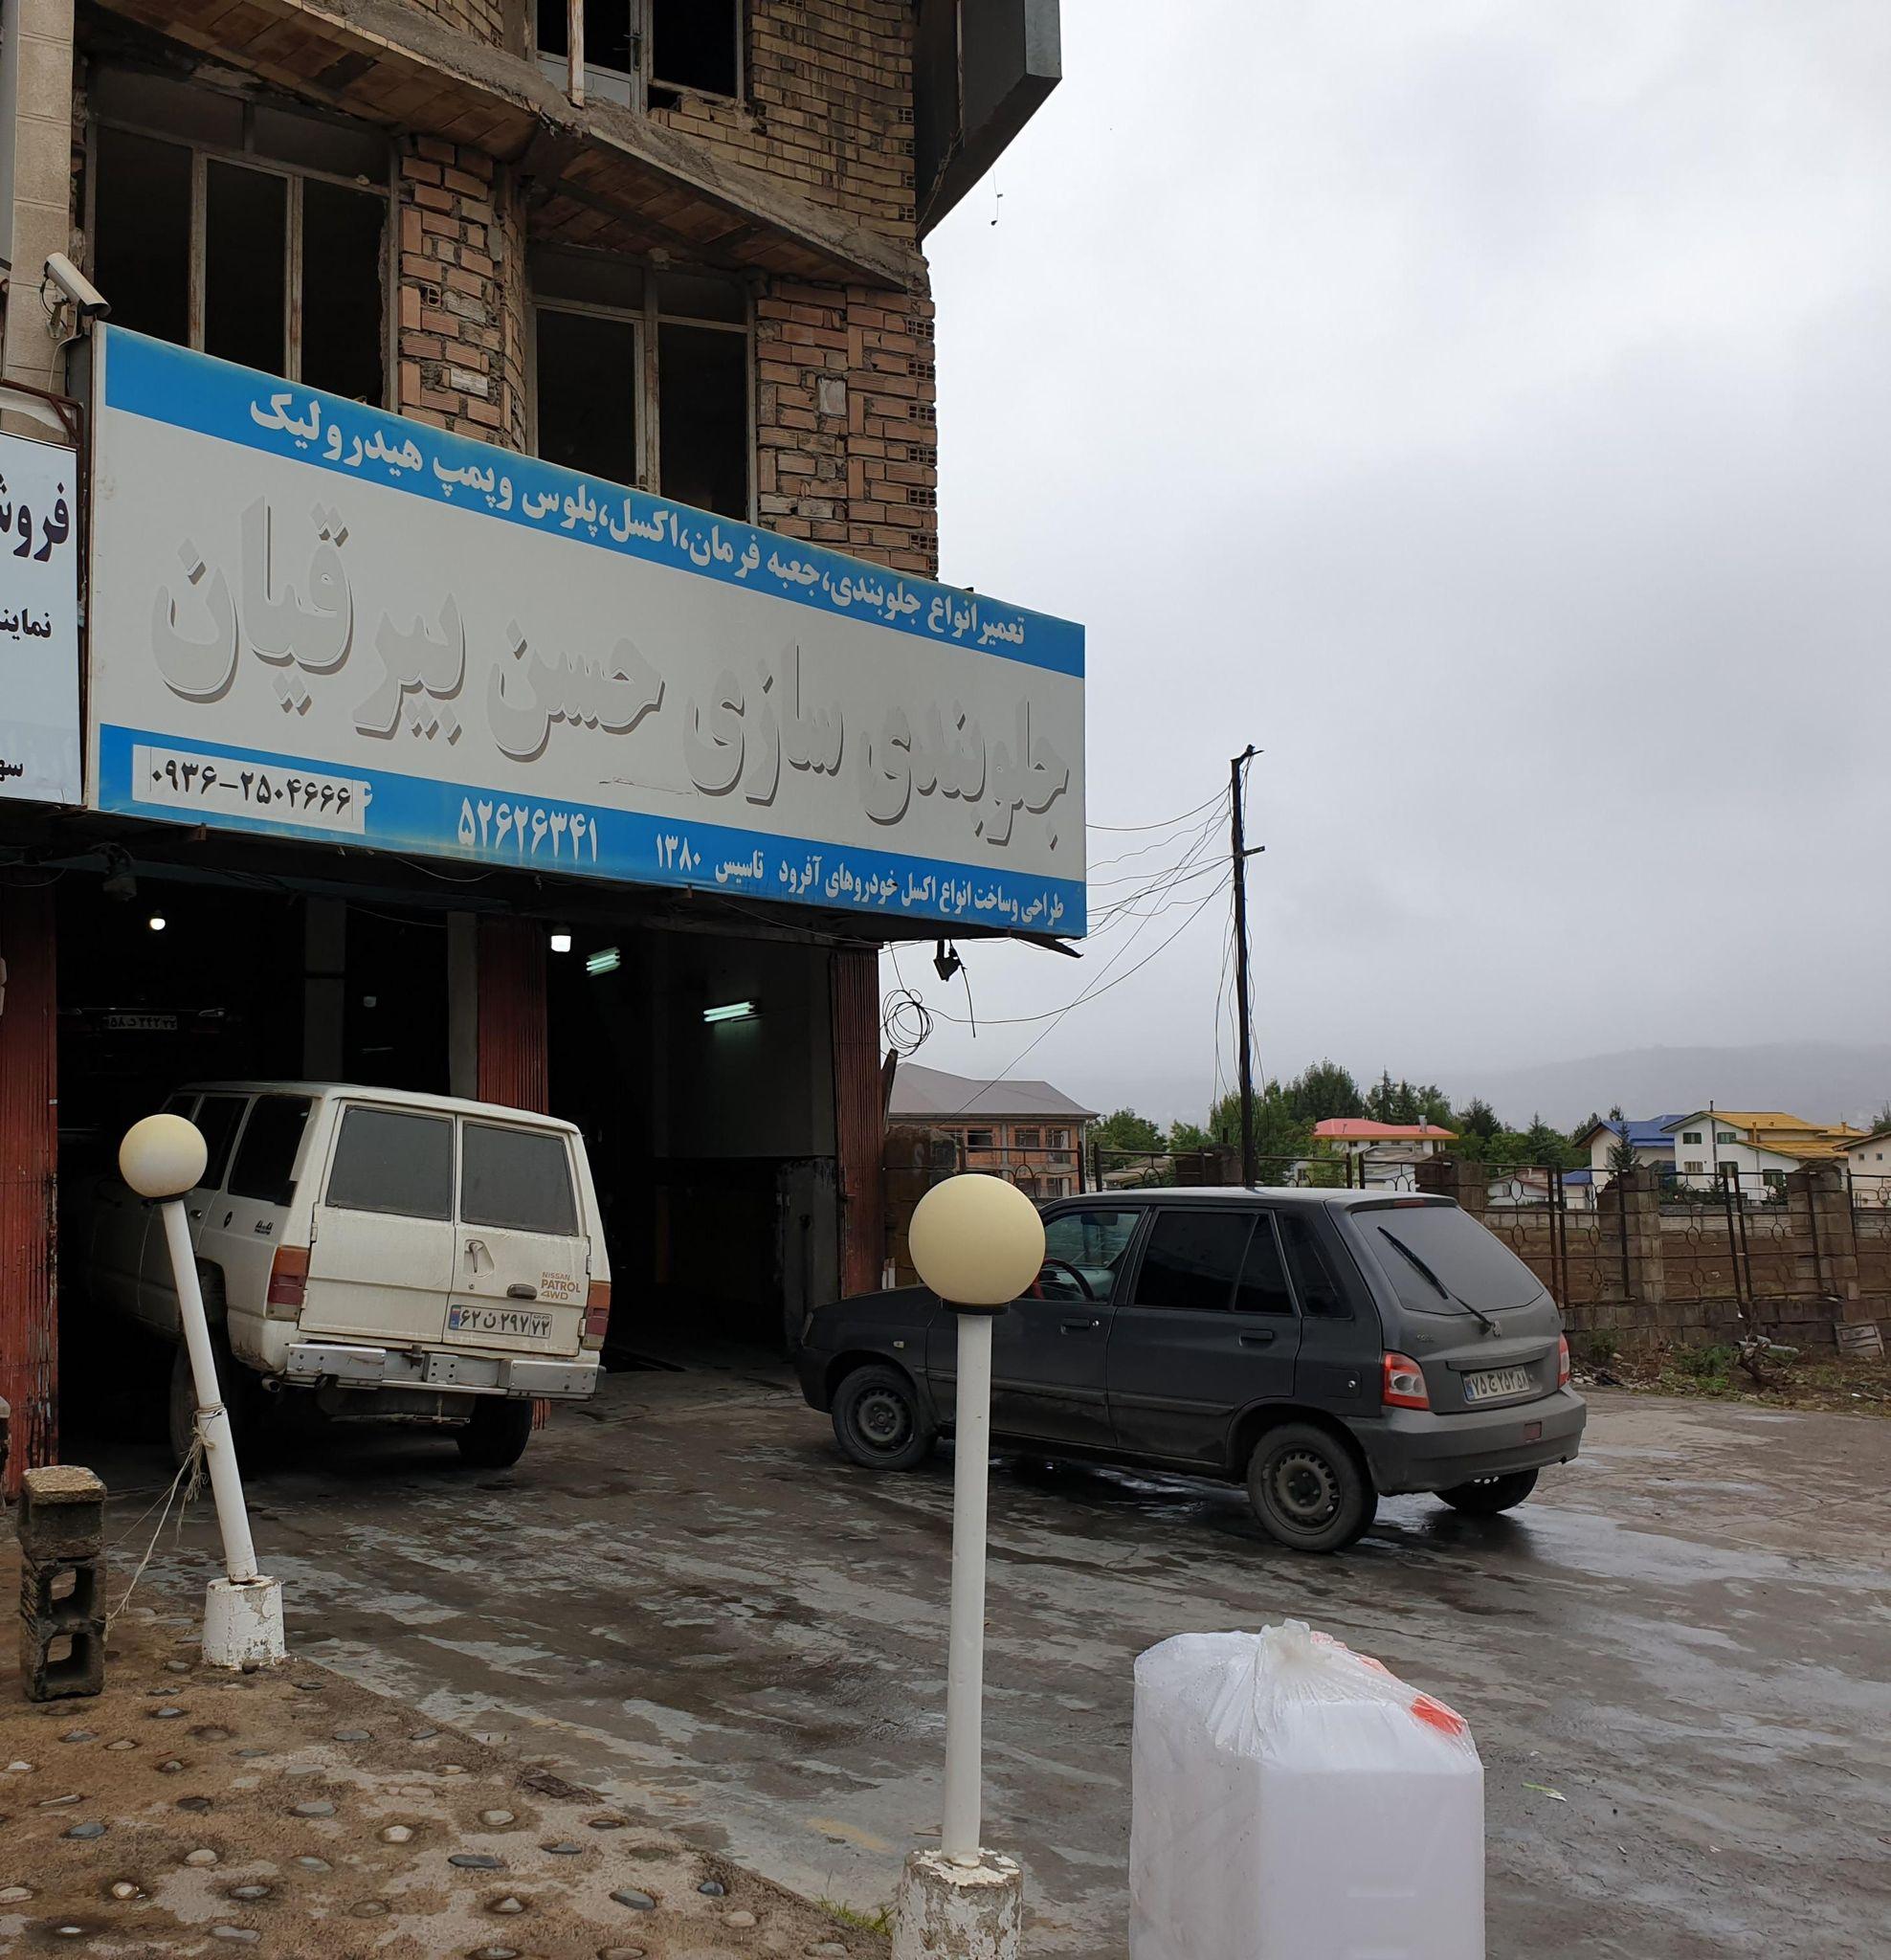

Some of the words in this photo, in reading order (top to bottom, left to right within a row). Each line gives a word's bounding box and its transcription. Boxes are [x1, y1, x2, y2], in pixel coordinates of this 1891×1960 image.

[250, 393, 423, 478] هیدرولیک
[927, 595, 977, 638] انواع
[977, 616, 1025, 646] تعمیر
[486, 618, 666, 764] حسن
[683, 635, 844, 808] سازی
[860, 693, 1070, 851] جلوبندی
[457, 796, 598, 862] ۵۲۶۲۶۳۴۱
[656, 833, 702, 872] ۱۳۸۰
[716, 849, 765, 883] تاسیس
[778, 855, 823, 895] آفرود
[825, 862, 899, 905] خودروهای
[901, 872, 937, 907] اکسل
[940, 878, 972, 915] انواع
[1021, 890, 1065, 926] طراحی
[541, 1279, 581, 1294] PATROL
[541, 1290, 568, 1301] 4WD
[542, 1272, 570, 1281] NISSAN
